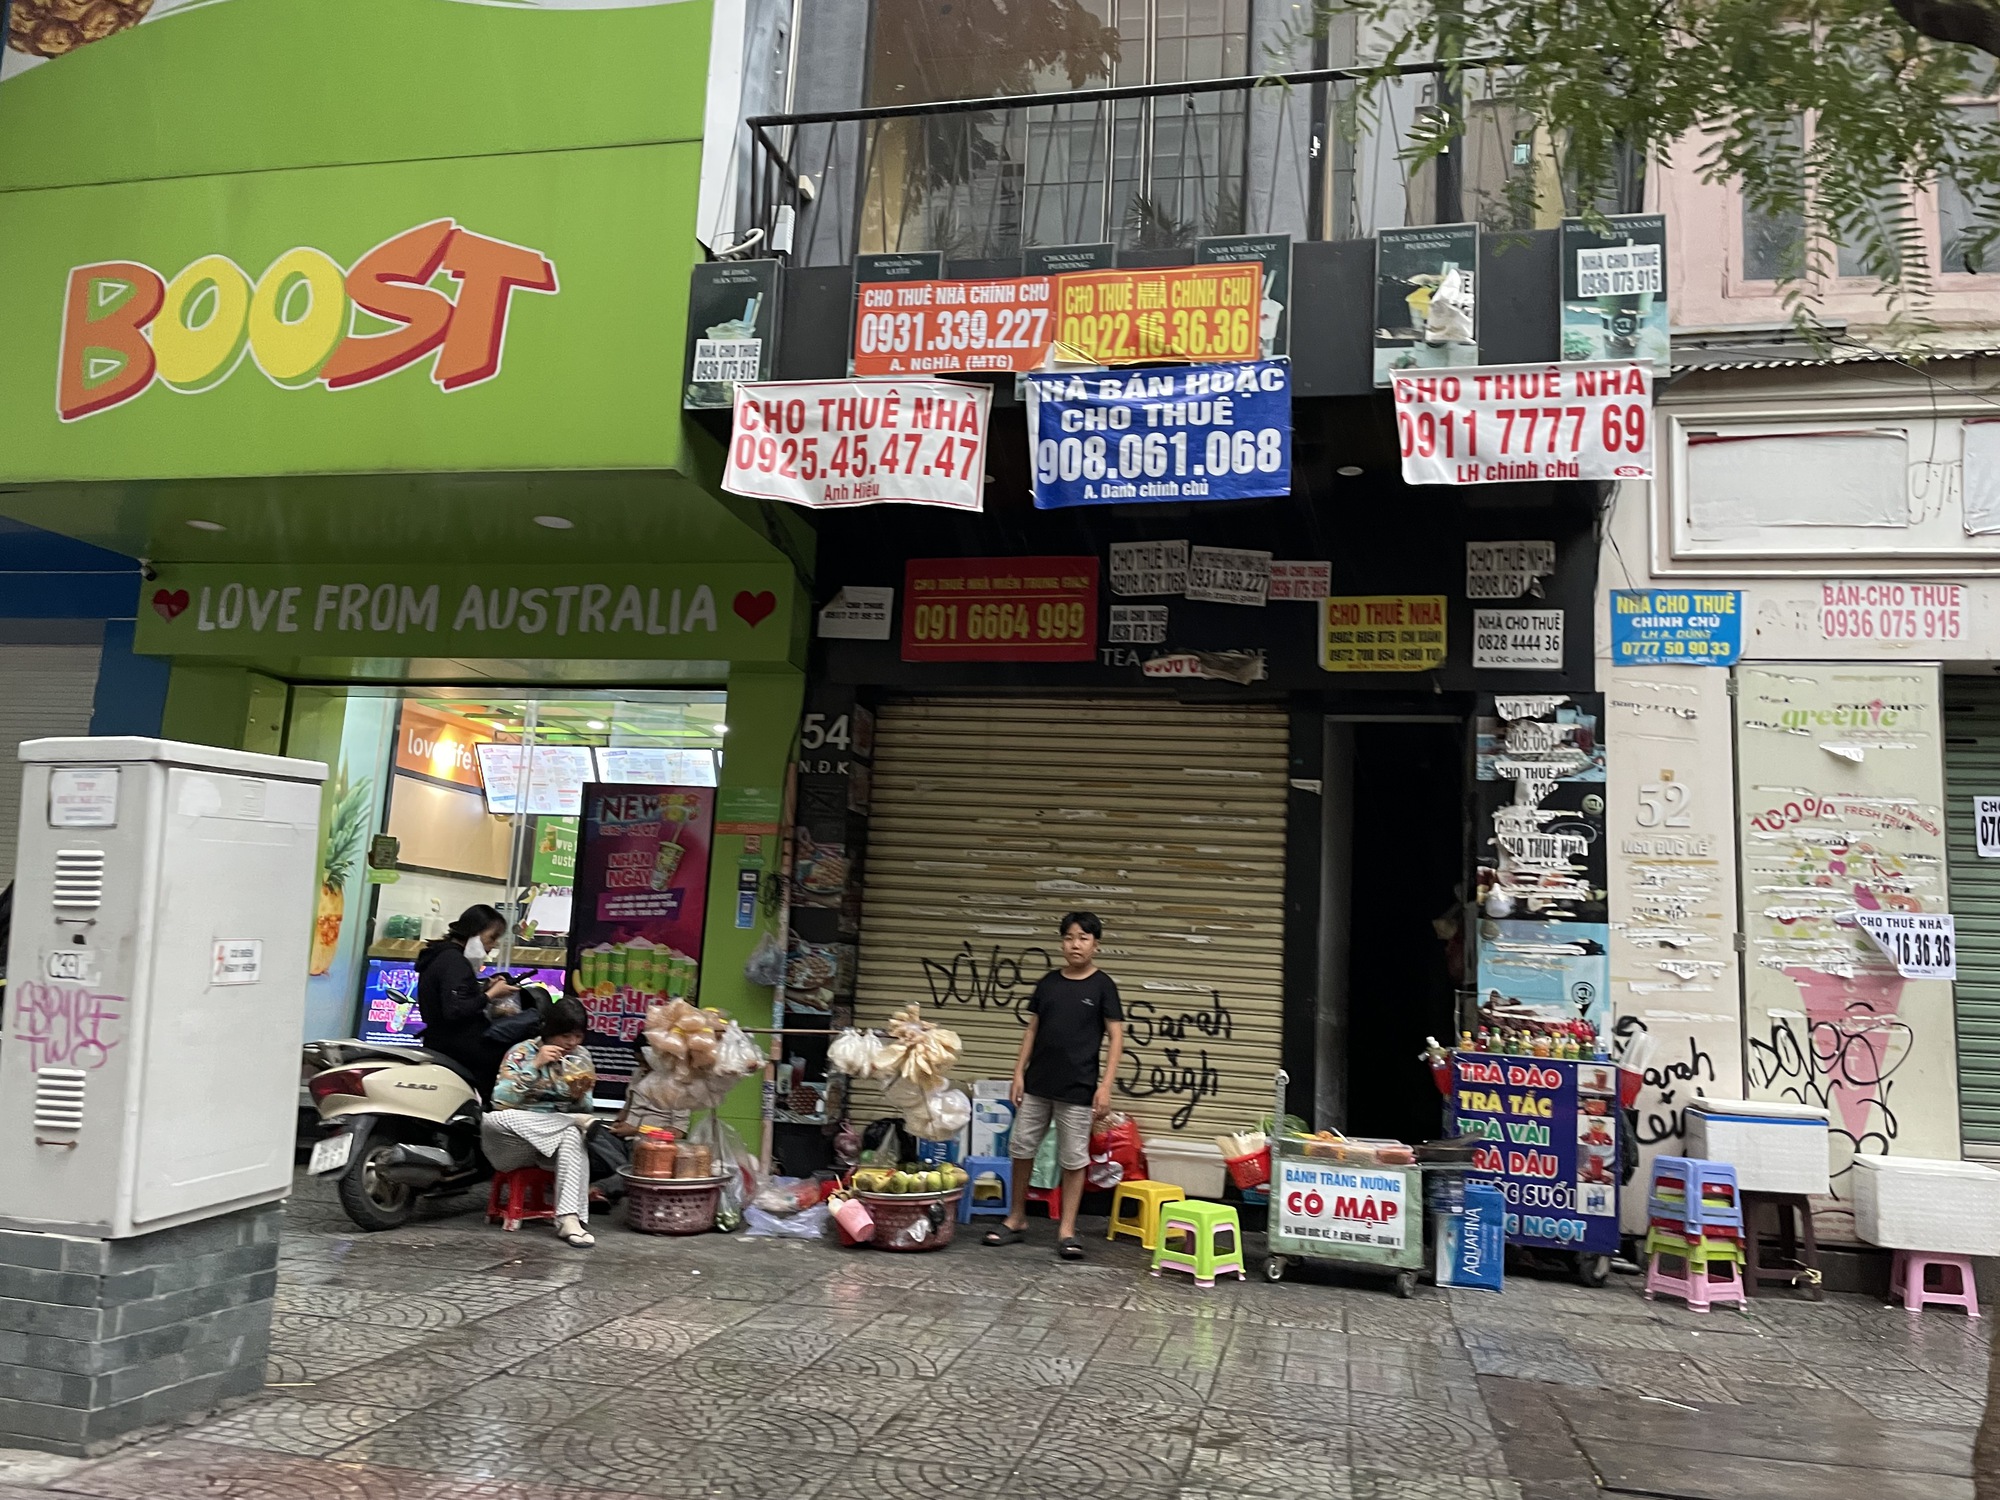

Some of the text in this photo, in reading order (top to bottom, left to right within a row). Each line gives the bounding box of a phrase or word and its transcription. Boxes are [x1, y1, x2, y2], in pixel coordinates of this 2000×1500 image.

[1582, 251, 1603, 270] NHÀ
[1606, 252, 1628, 268] CHO
[864, 277, 1050, 307] CHO THUÊ NHÀ CHÍNH CHỦ
[1065, 269, 1251, 314] CHO THUÊ NHÀ CHÍNH CHỦ
[1582, 270, 1659, 294] 0936 075 915
[57, 217, 559, 422] BOOST
[861, 308, 1049, 354] 0931.339.227
[1064, 308, 1250, 358] 0922.16.36.36
[740, 360, 757, 379] 915
[911, 354, 960, 370] NGHĨA
[1099, 372, 1174, 399] BÁN
[1185, 366, 1285, 398] HOẶC
[1395, 363, 1645, 404] CHO THUÊ NHÀ
[740, 388, 979, 435] CHO THUÊ NHÀ
[1061, 396, 1234, 433] CHO THUÊ
[1399, 404, 1645, 459] 0911 7777 69
[735, 433, 978, 481] 0925.45.47.47
[1038, 428, 1282, 484] 908.061.068
[1457, 463, 1479, 483] LH
[824, 484, 848, 501] Anh
[197, 582, 720, 636] LOVE FROM AUSTRALIA
[1329, 598, 1442, 626] CHO THUÊ NHÀ
[1655, 595, 1689, 614] CHO
[1693, 591, 1735, 614] THUÊ
[914, 602, 1087, 641] 091 6664 999
[1478, 611, 1561, 631] NHÀ CHO THUÊ
[1631, 615, 1683, 628] CHÍNH
[1824, 609, 1960, 638] 0936 075 915
[1101, 648, 1140, 667] TEA
[1477, 635, 1560, 651] 0828 4444 36
[1622, 642, 1660, 655] 0777
[1664, 642, 1684, 655] 50
[801, 713, 851, 751] 54
[601, 796, 660, 823] NEW
[1636, 782, 1692, 828] 52
[1751, 797, 1836, 832] 100%
[1844, 804, 1881, 820] FRESH
[607, 869, 653, 888] NGAY
[1860, 916, 1882, 927] CHO
[1886, 916, 1914, 929] THUÊ
[1127, 990, 1232, 1046] Sarah
[394, 1082, 439, 1091] LEAD
[1118, 1048, 1218, 1131] Leigh
[1458, 1060, 1562, 1090] TRÀ ĐÀO
[1458, 1089, 1506, 1114] TRÀ
[1472, 1145, 1559, 1179] RÀ DÂU
[1287, 1188, 1398, 1229] CÔ MẬP
[1462, 1207, 1483, 1277] AQUAFINA
[1523, 1214, 1587, 1245] NGỌT
